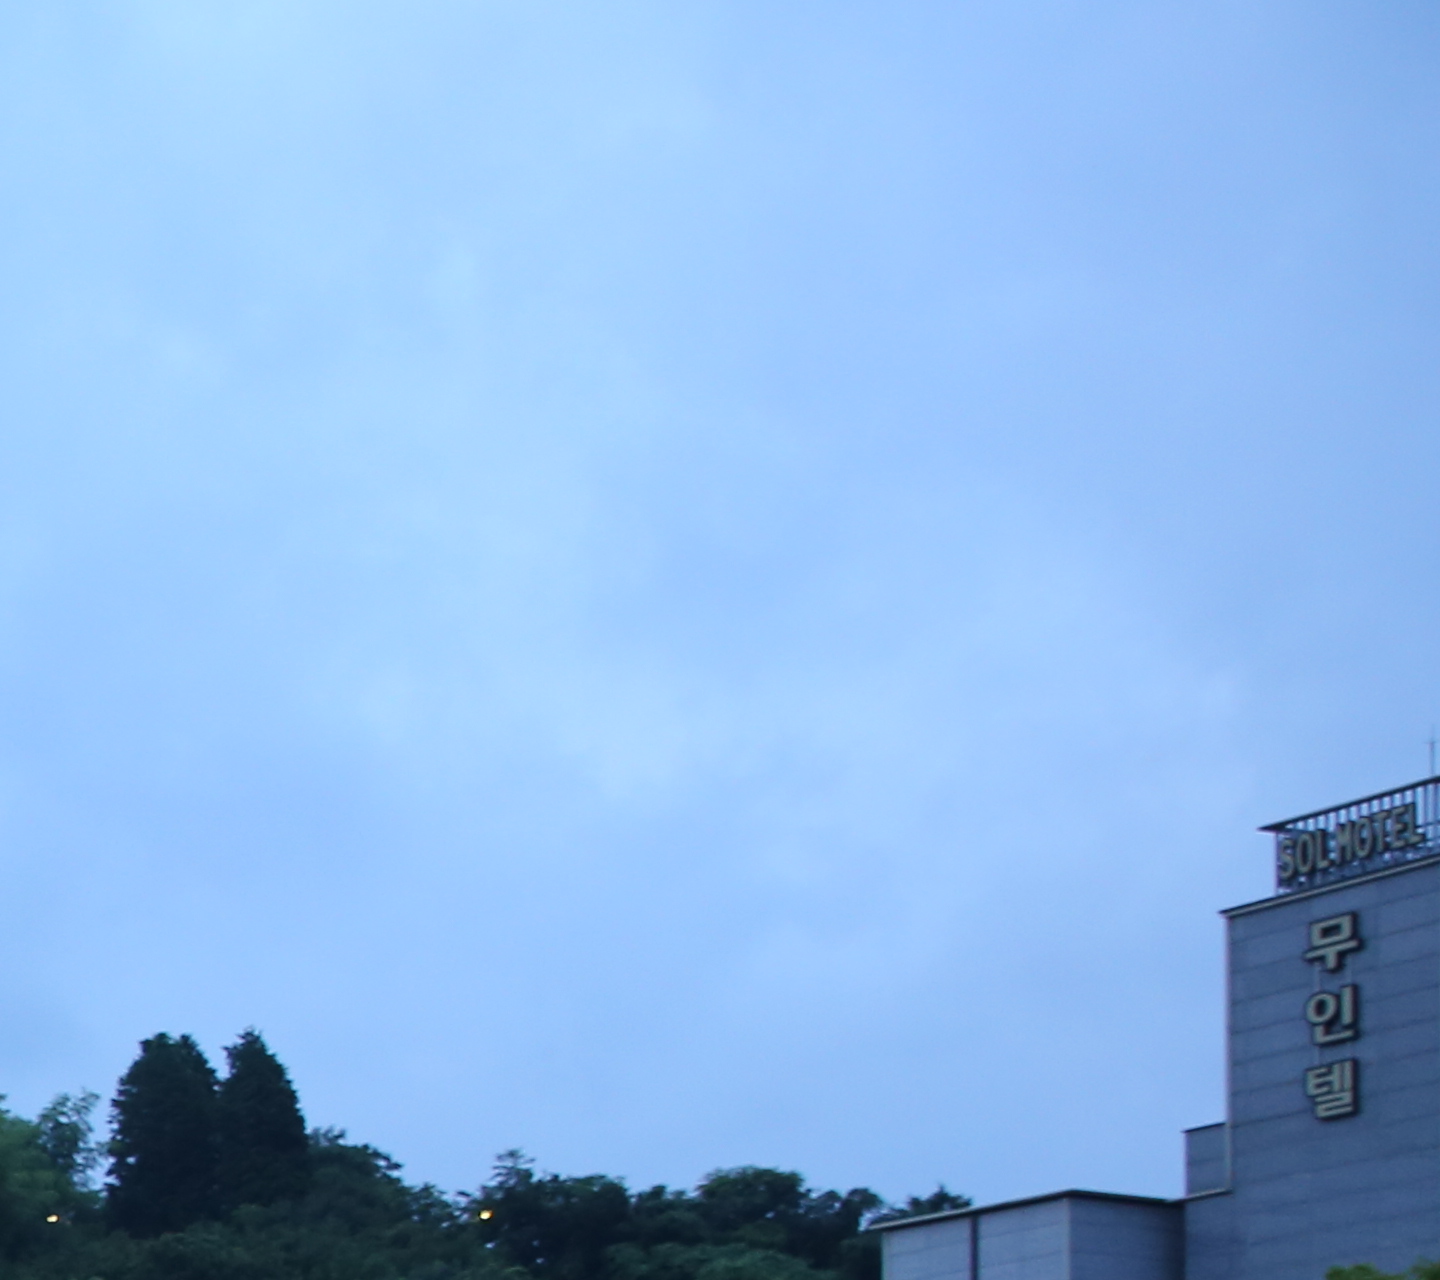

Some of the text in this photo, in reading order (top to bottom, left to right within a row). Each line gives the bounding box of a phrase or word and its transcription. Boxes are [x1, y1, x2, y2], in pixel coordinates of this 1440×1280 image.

[1279, 802, 1425, 881] SOL MOTEL
[1303, 911, 1362, 1121] 무인텔
